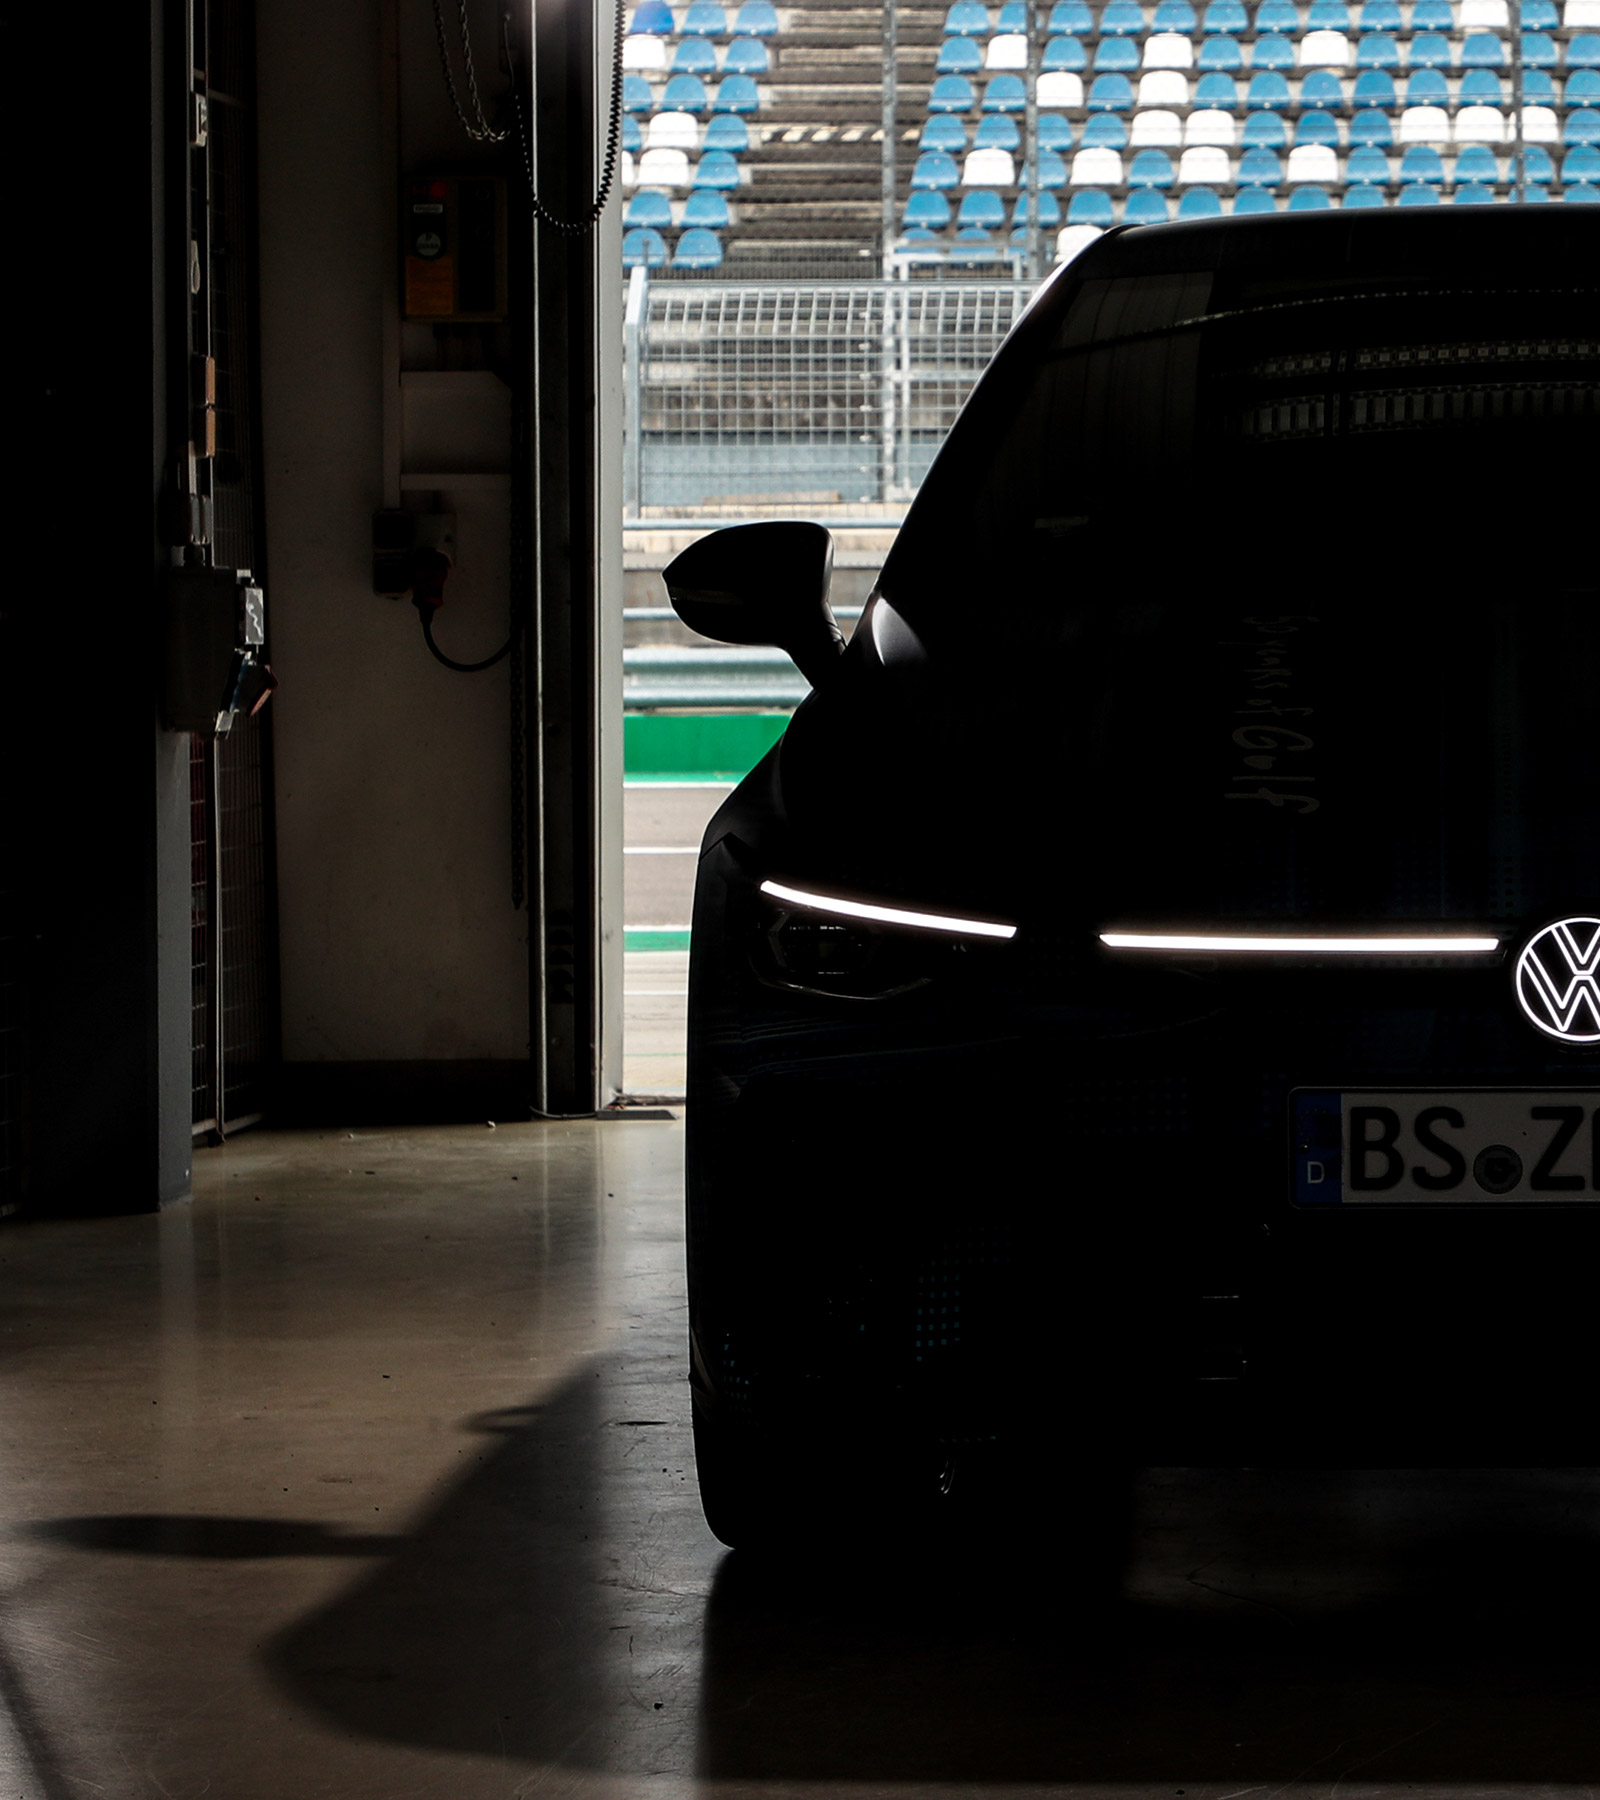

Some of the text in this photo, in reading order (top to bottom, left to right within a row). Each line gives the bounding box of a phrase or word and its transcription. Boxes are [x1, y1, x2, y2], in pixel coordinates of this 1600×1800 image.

[1232, 696, 1315, 717] of
[1223, 724, 1321, 815] Golf
[1306, 1161, 1325, 1184] D
[1349, 1106, 1466, 1192] BS
